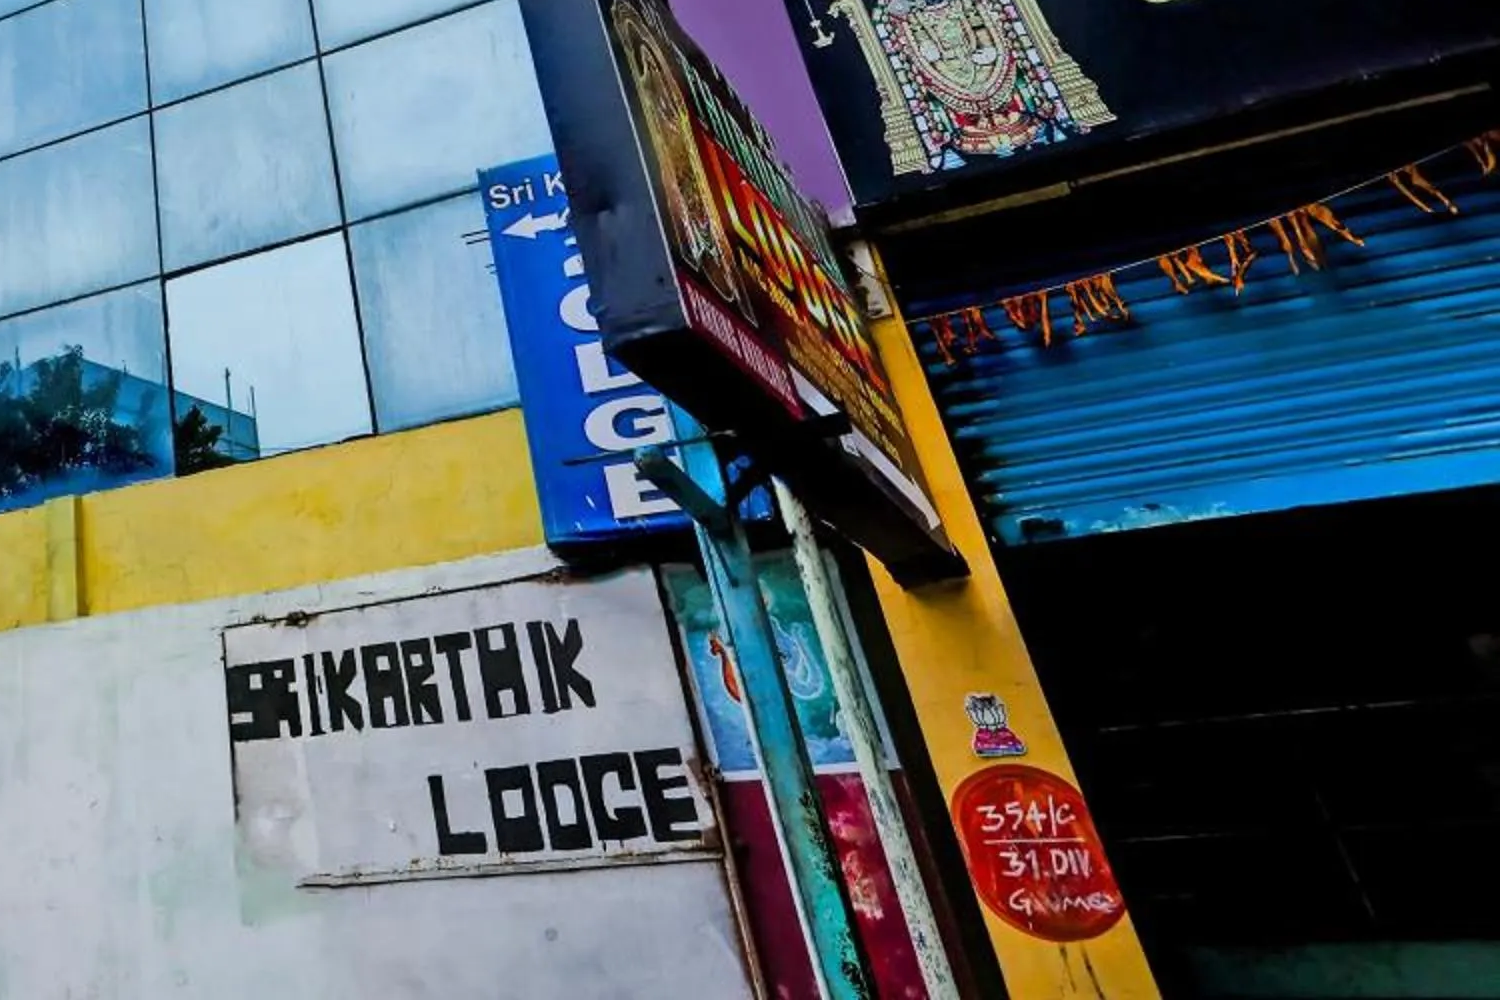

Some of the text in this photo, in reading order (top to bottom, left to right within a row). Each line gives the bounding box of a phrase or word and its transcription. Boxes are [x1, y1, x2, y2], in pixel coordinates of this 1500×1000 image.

[489, 170, 567, 210] Sri K
[427, 747, 703, 856] LODGE
